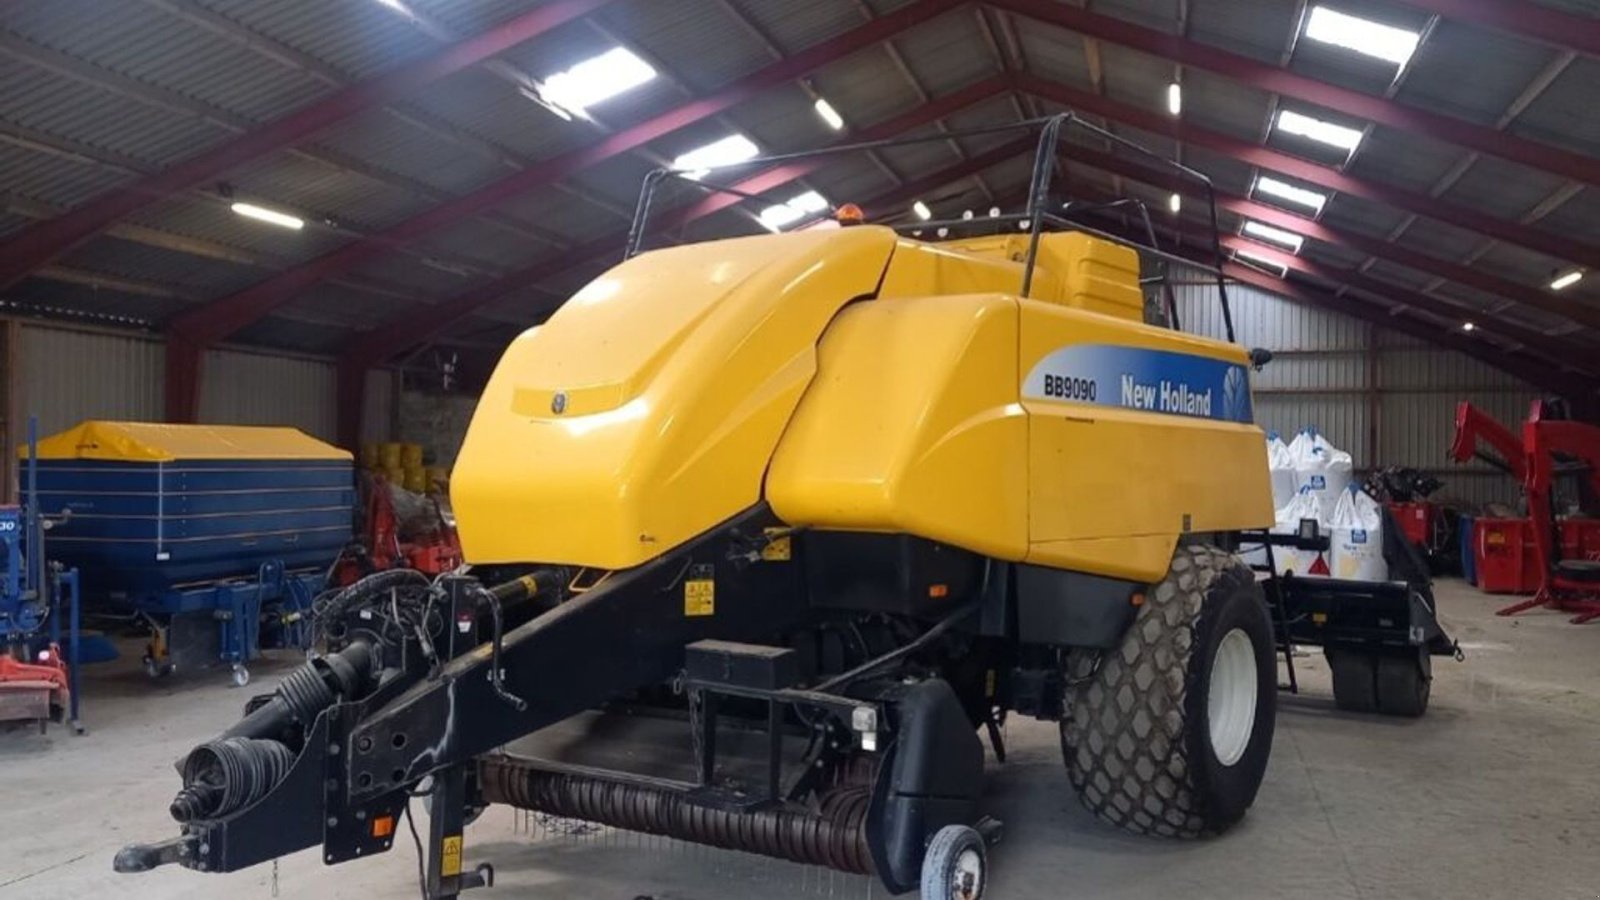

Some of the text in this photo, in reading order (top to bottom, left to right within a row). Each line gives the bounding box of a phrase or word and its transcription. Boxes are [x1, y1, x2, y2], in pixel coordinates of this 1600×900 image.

[1044, 374, 1097, 402] BB9090
[1121, 374, 1211, 417] New Holland
